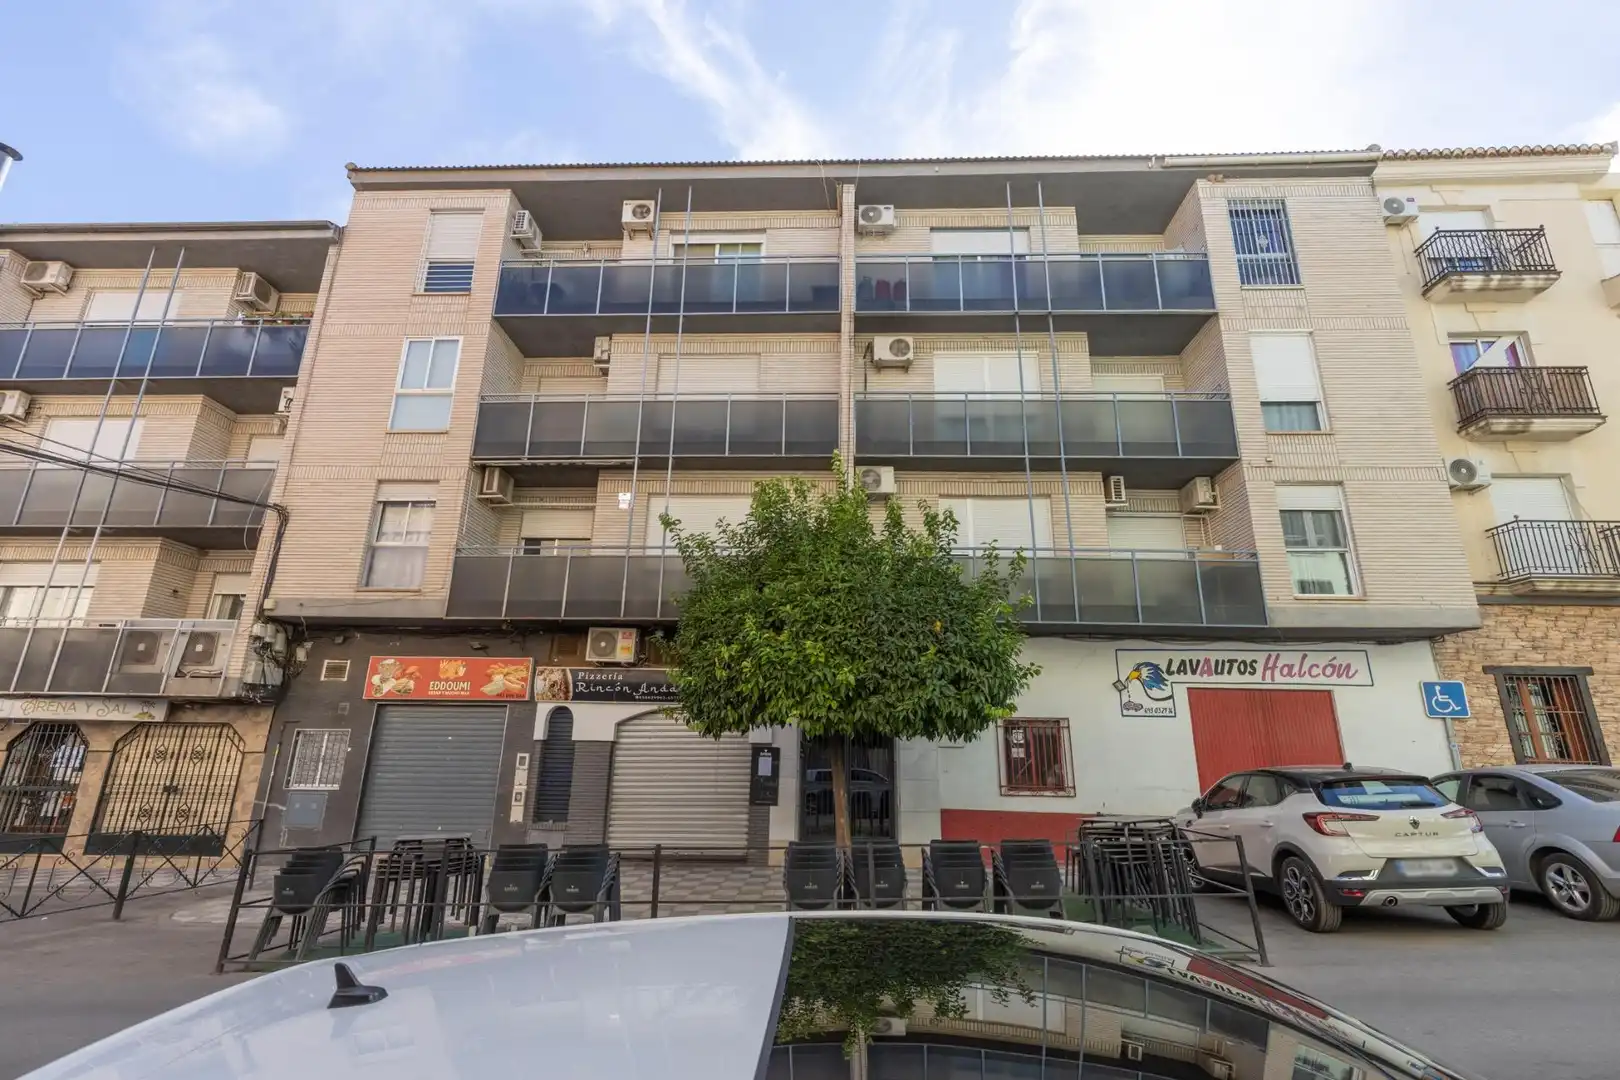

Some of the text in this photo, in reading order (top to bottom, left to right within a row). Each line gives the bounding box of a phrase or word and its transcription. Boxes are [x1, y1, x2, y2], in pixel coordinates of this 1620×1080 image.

[1165, 652, 1359, 682] LAVAUTOS Halcón
[575, 681, 678, 695] Rincón Anda
[21, 698, 76, 715] ARENA
[85, 700, 93, 713] Y
